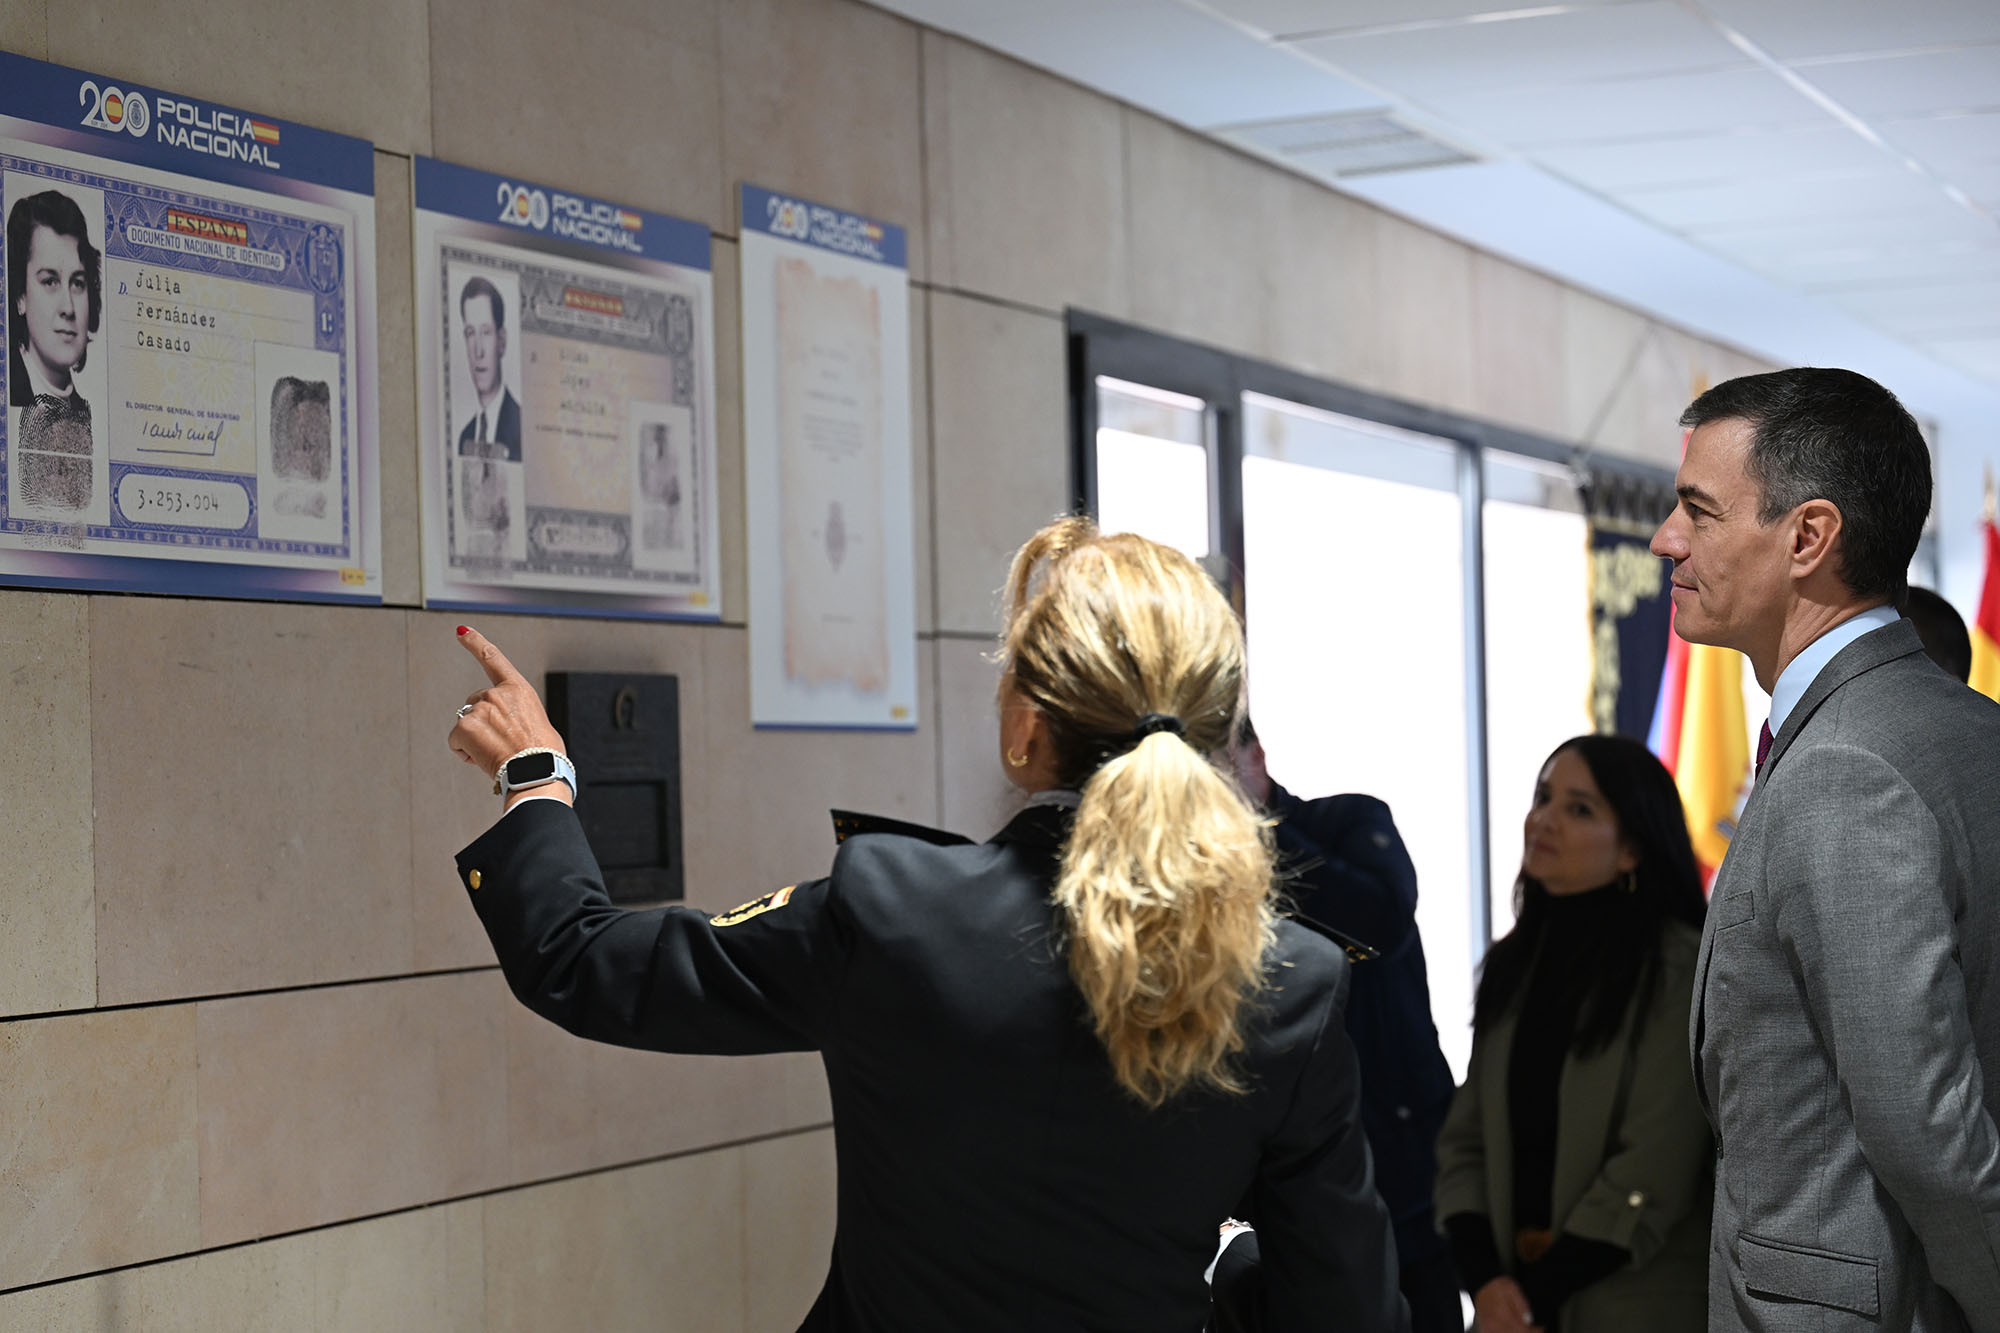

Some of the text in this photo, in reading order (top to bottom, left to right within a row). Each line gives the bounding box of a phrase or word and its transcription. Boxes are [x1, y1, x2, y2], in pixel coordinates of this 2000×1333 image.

[79, 80, 150, 138] 200
[156, 123, 280, 169] NACIONAL
[131, 228, 281, 268] DOCUMENTO NACIONAL DE IDENTIDAD
[552, 216, 644, 253] NACIONAL
[136, 268, 182, 296] Julia
[136, 302, 217, 329] Fernández
[137, 331, 191, 353] Casado
[125, 401, 133, 409] EL
